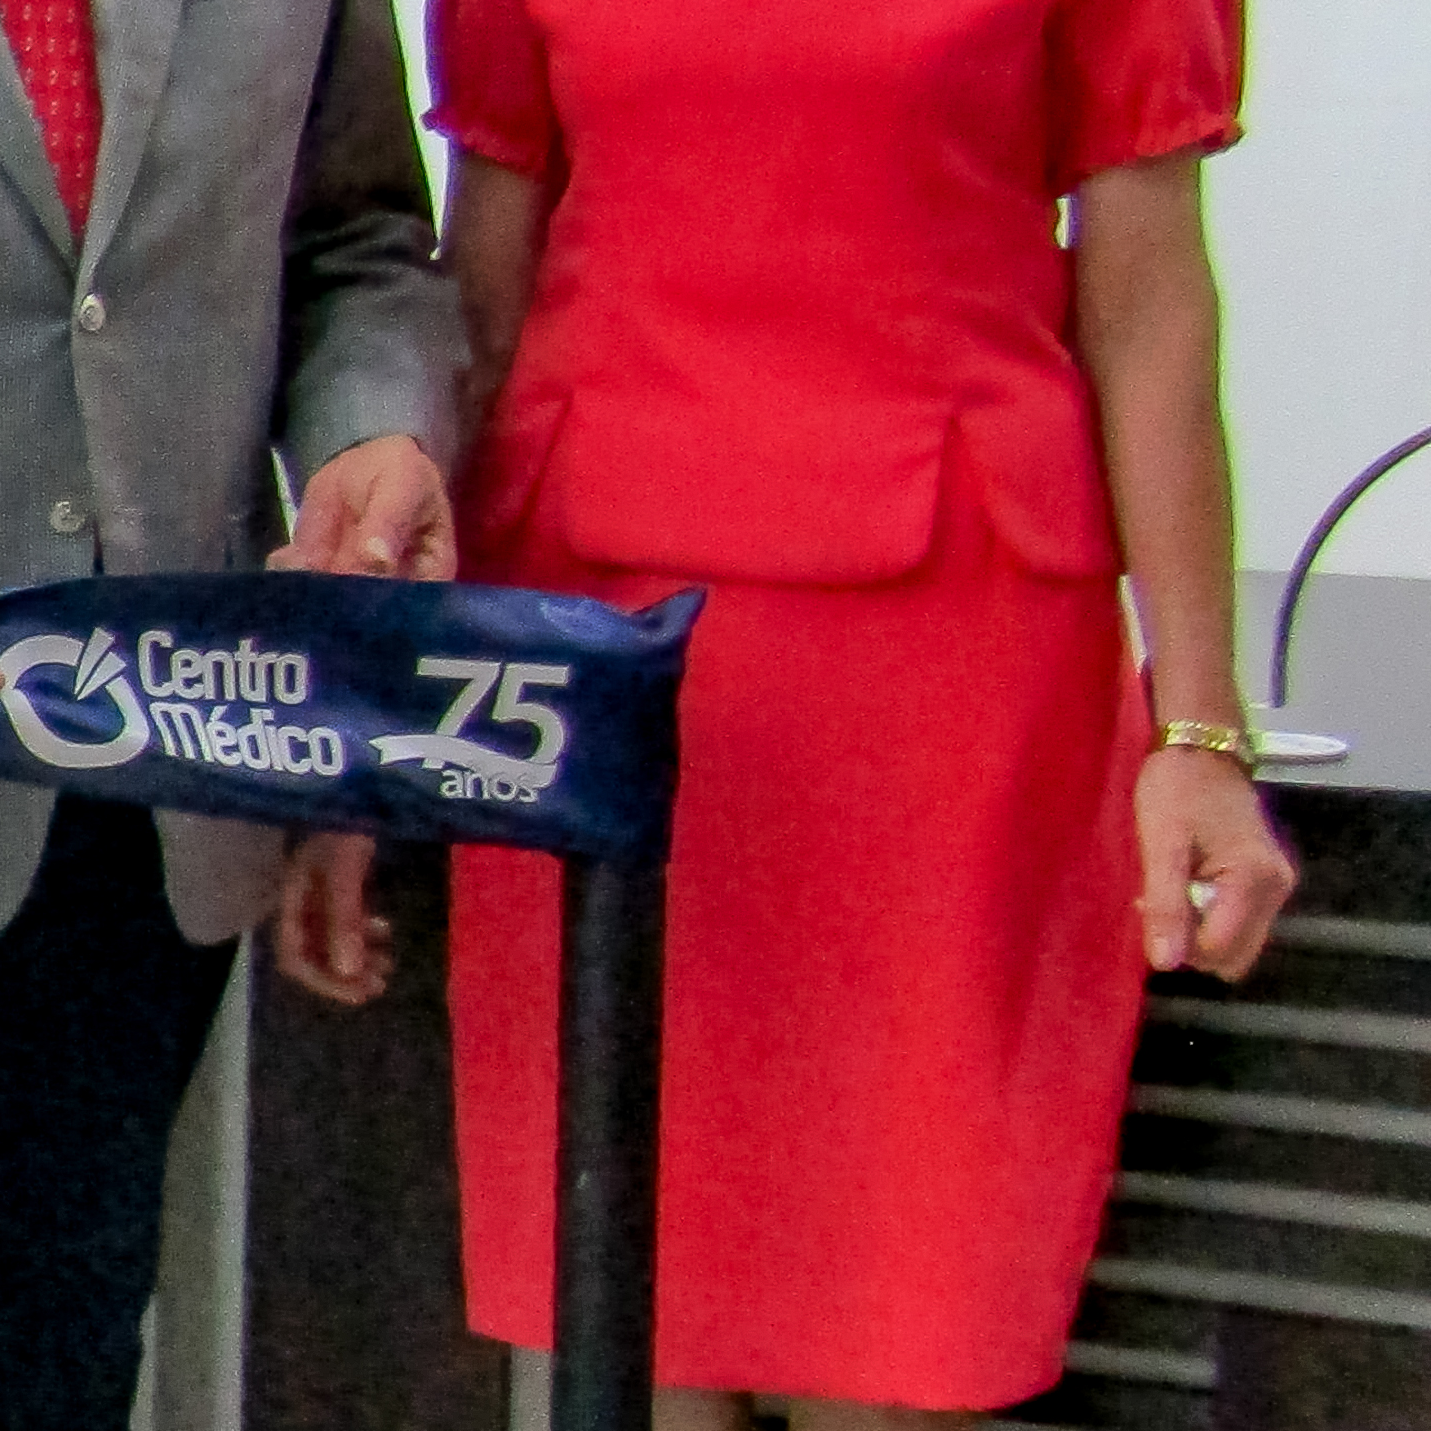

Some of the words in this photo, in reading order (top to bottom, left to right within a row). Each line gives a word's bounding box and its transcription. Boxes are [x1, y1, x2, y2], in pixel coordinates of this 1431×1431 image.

[137, 630, 309, 705] Centro
[148, 700, 345, 776] Médico
[416, 656, 570, 769] 75
